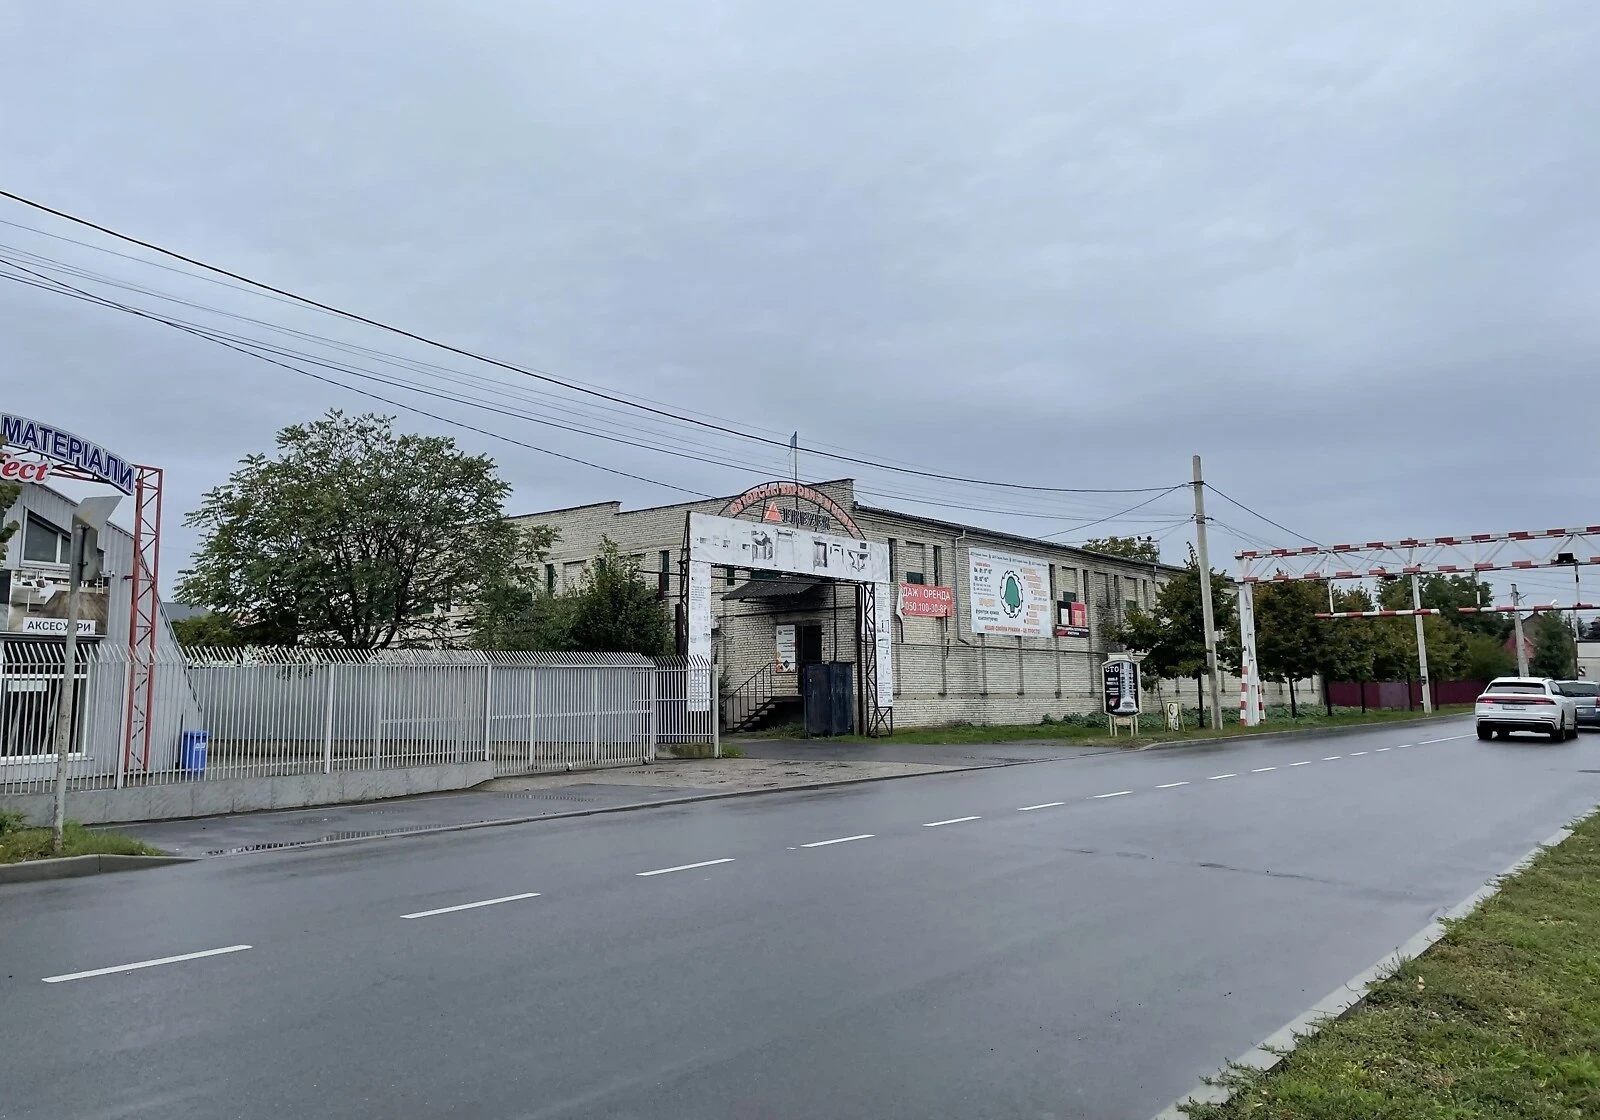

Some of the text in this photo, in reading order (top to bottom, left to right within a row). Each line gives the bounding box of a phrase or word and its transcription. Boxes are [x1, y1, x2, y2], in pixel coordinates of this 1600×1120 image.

[2, 416, 133, 490] МАТЕРІАЛИ
[923, 589, 950, 601] ОРЕНДА
[905, 601, 917, 611] 050
[27, 621, 91, 632] АКСЕСУРИ
